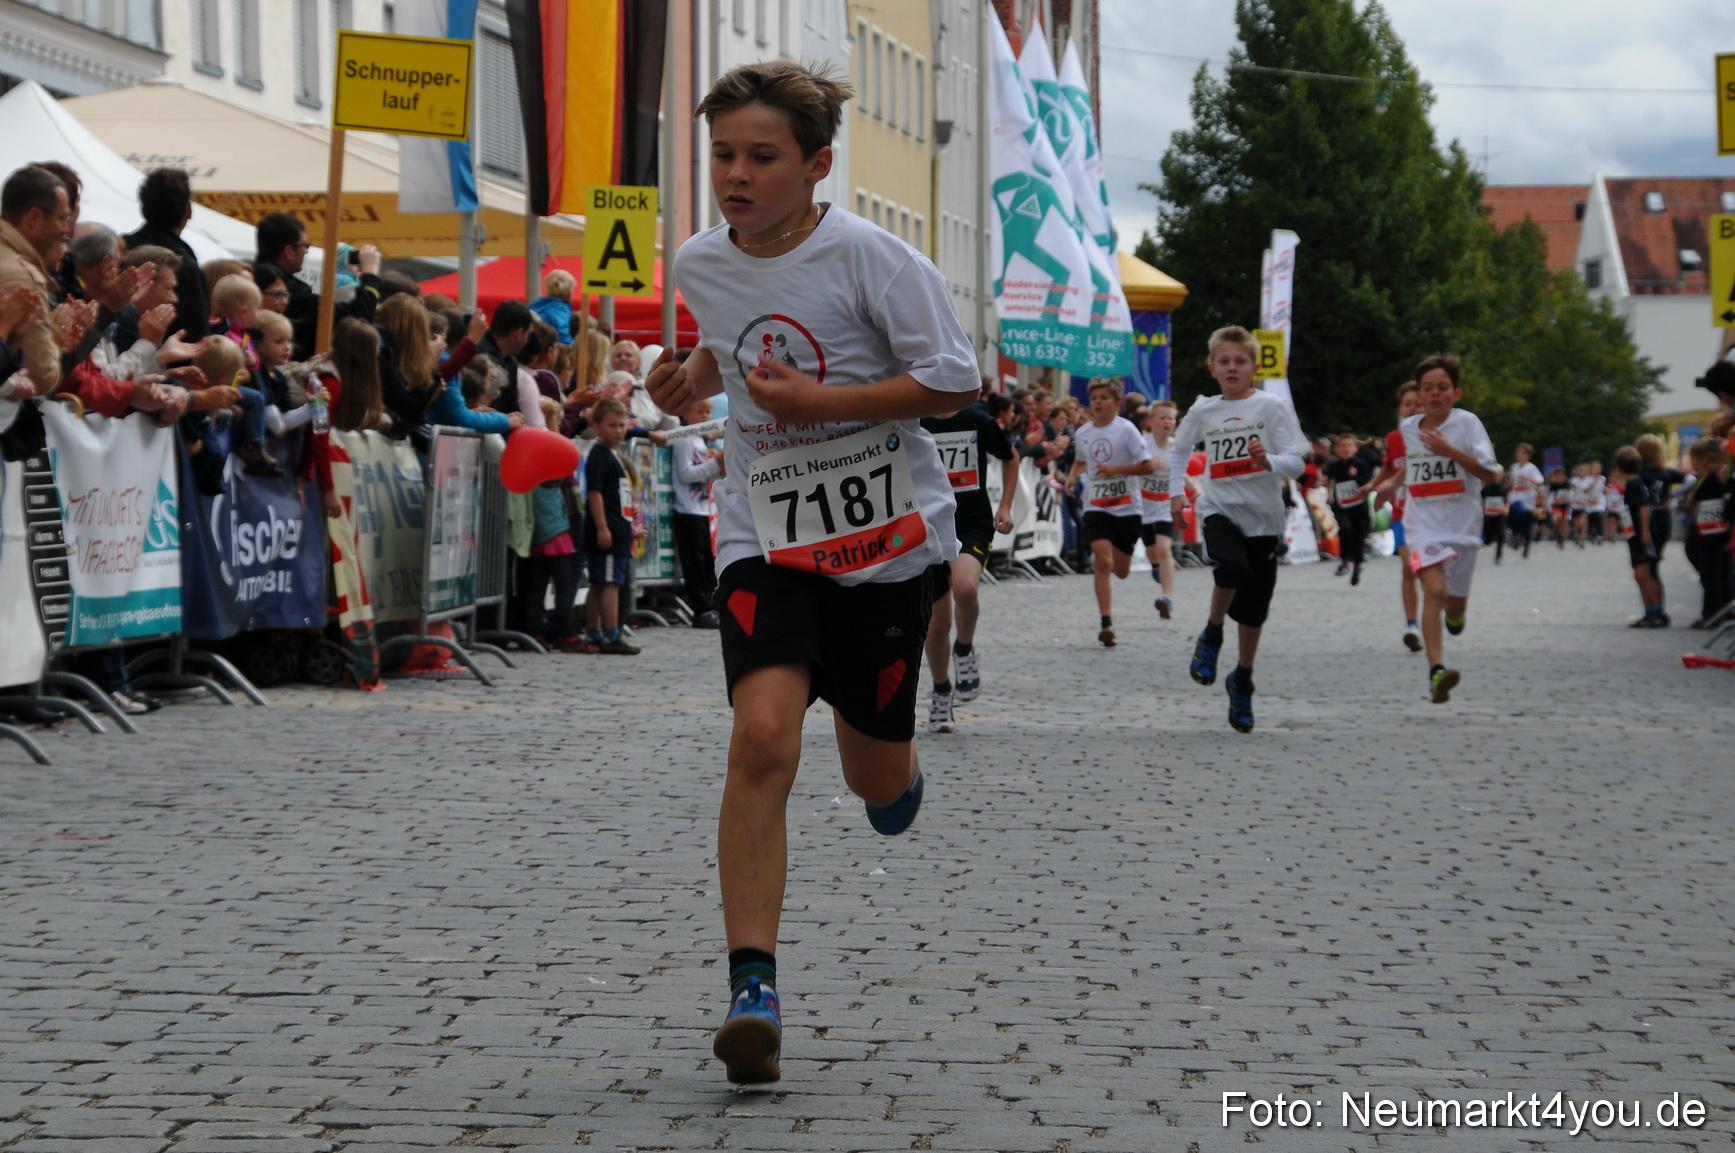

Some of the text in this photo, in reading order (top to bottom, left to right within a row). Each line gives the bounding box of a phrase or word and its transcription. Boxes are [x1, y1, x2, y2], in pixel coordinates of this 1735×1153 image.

[344, 59, 461, 88] Schnupper-
[382, 90, 420, 111] lauf
[593, 189, 649, 210] Block
[598, 218, 639, 272] A
[1002, 327, 1079, 346] rvice-Line:
[1261, 345, 1278, 369] B
[1211, 433, 1261, 462] 722
[750, 443, 883, 487] PARTL Neumarkt
[1412, 459, 1458, 482] 7344
[1093, 480, 1127, 498] 7290
[769, 462, 895, 544] 7187
[811, 534, 890, 572] Patrick
